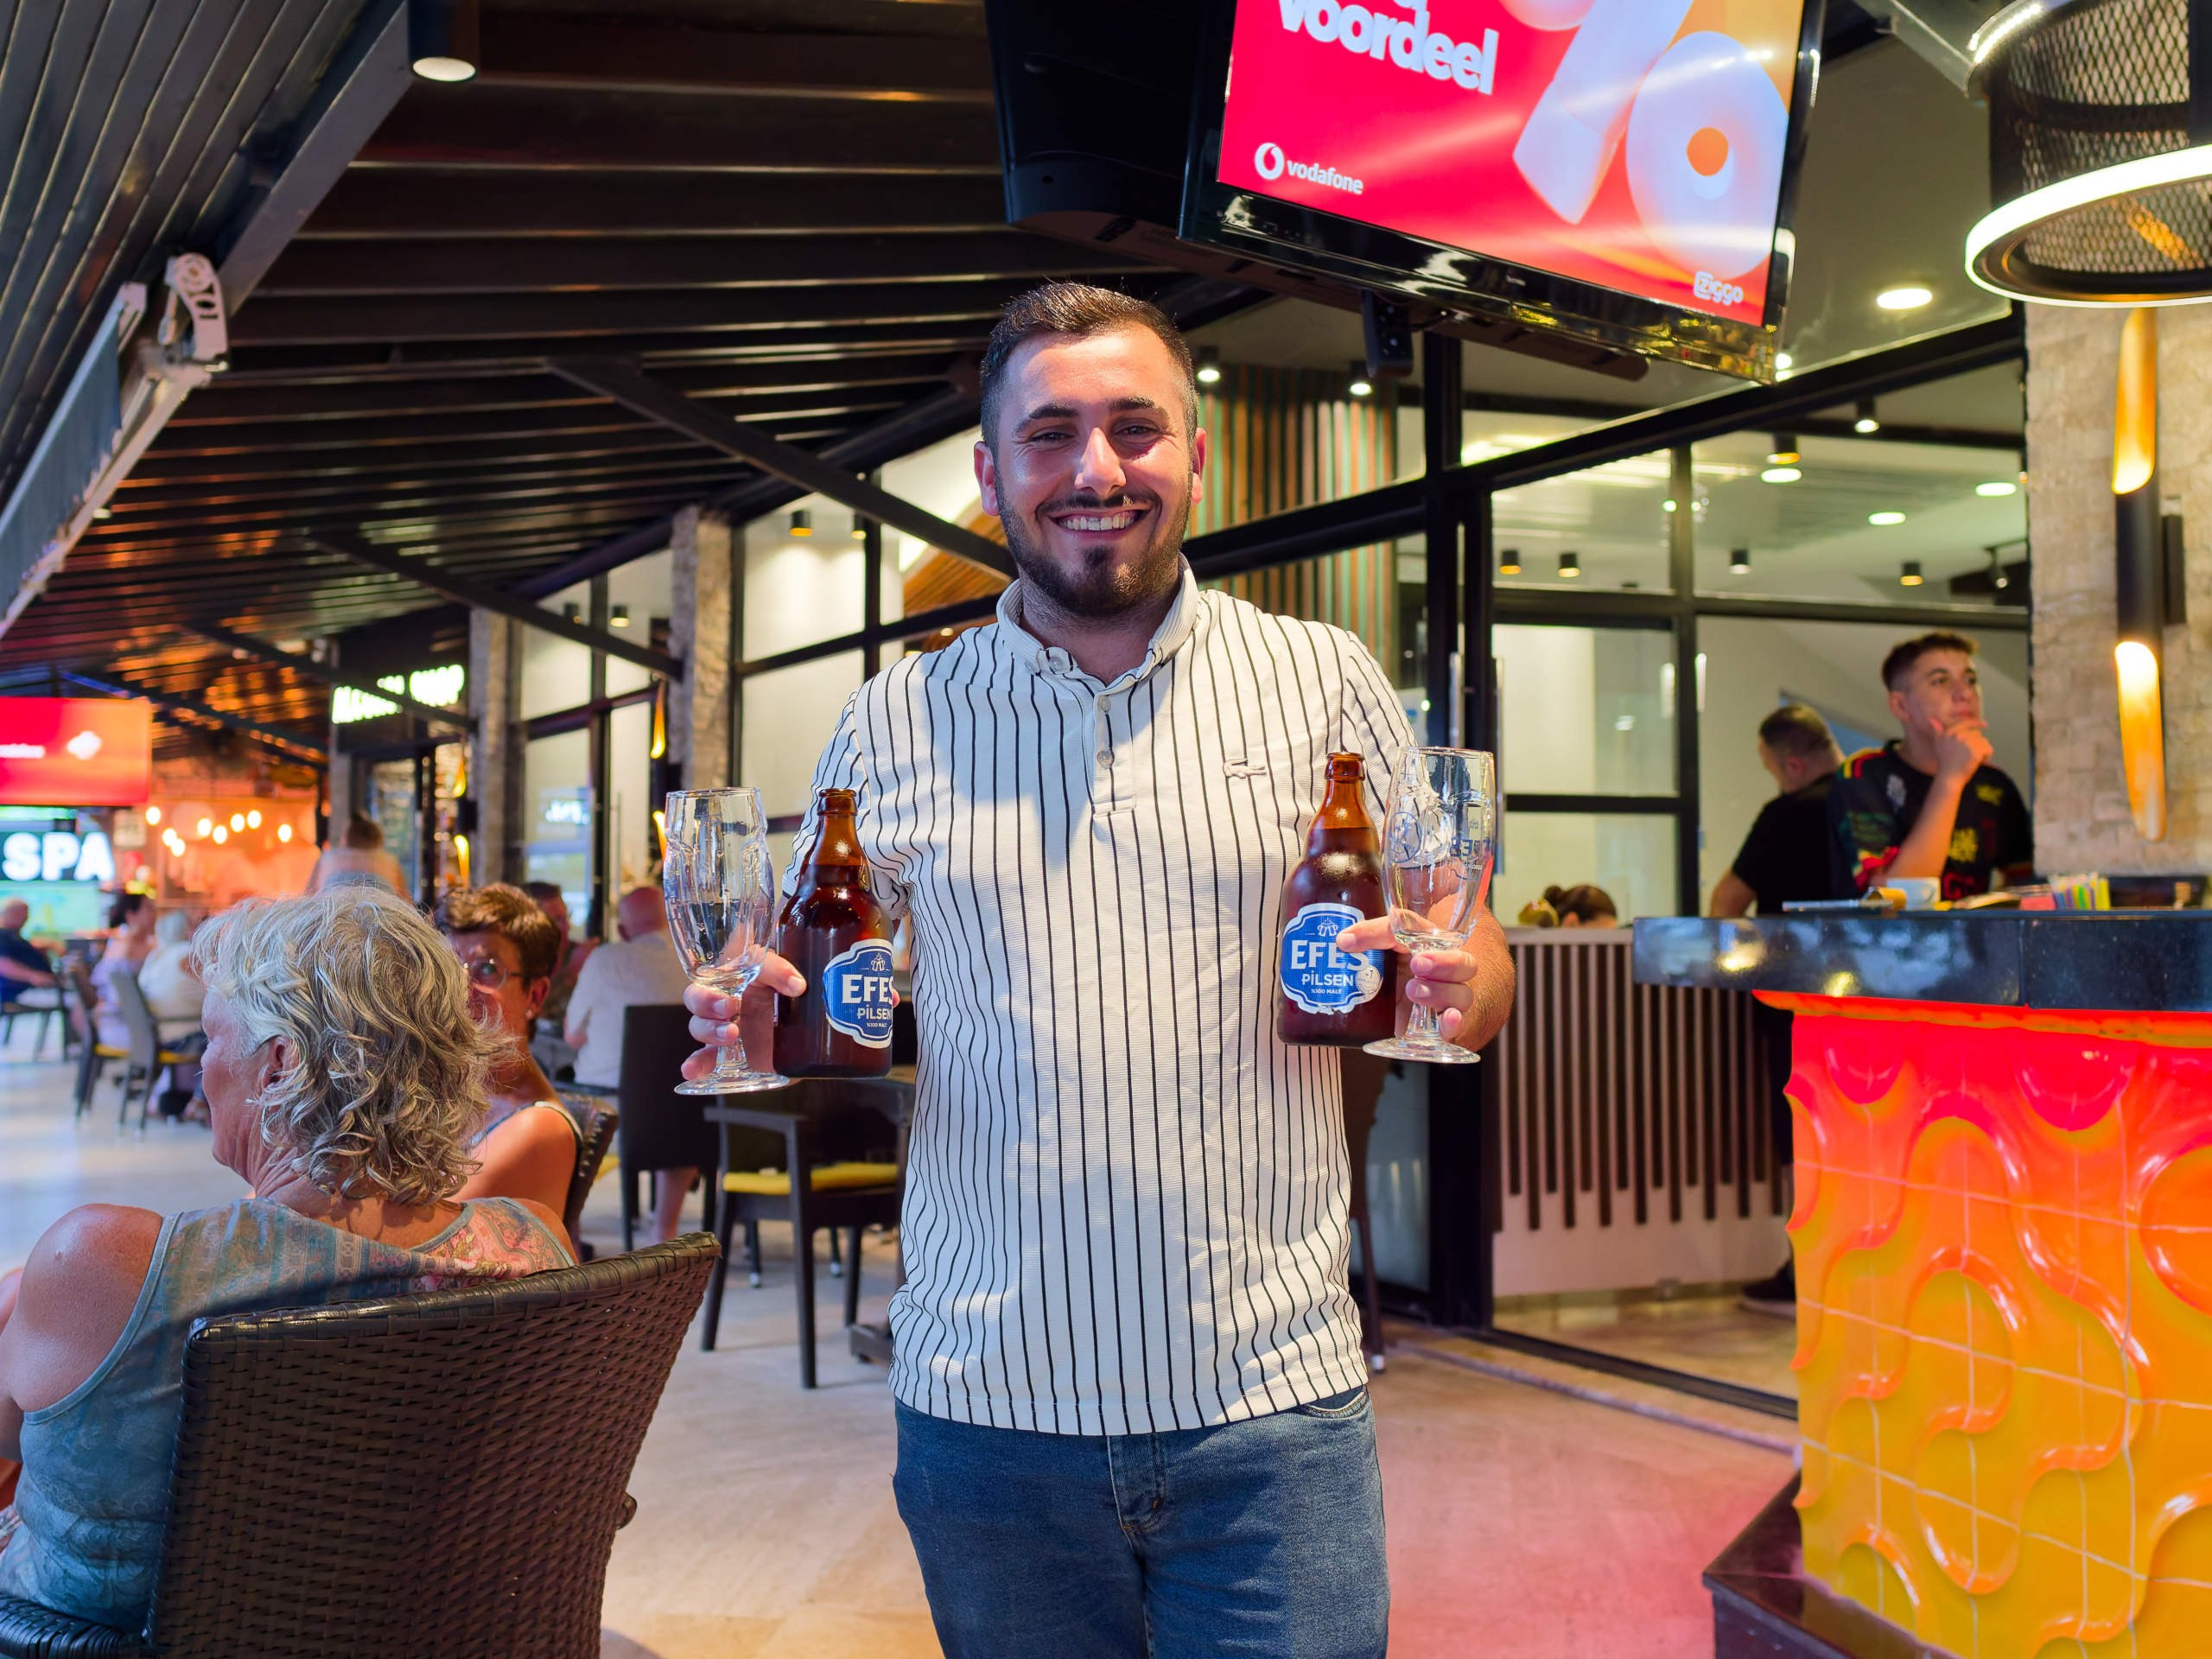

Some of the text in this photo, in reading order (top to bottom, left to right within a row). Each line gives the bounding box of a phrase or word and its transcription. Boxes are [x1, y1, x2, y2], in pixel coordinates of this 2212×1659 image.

[1279, 0, 1499, 95] voordeel
[1287, 160, 1363, 195] vodafone
[3, 831, 115, 881] SPA
[1290, 939, 1370, 971] EFES
